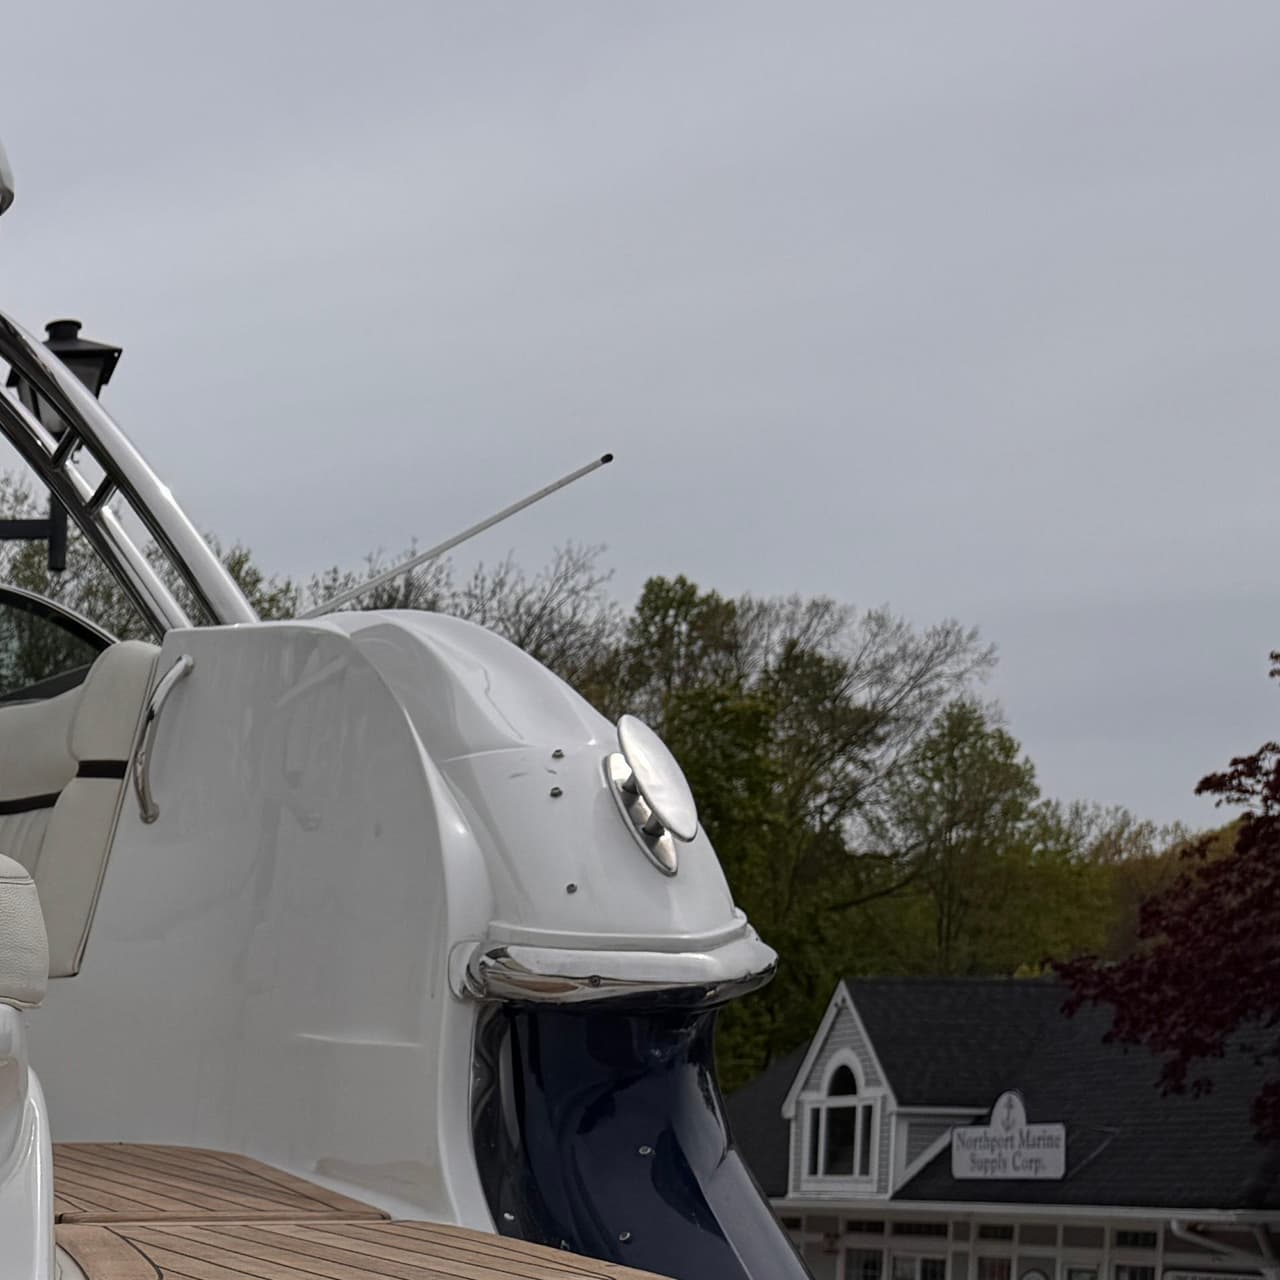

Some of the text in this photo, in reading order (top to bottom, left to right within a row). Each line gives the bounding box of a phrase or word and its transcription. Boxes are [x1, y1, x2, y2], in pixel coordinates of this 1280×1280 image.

[956, 1128, 1061, 1154] Northport Marine
[969, 1150, 1046, 1176] Supply Corp.
